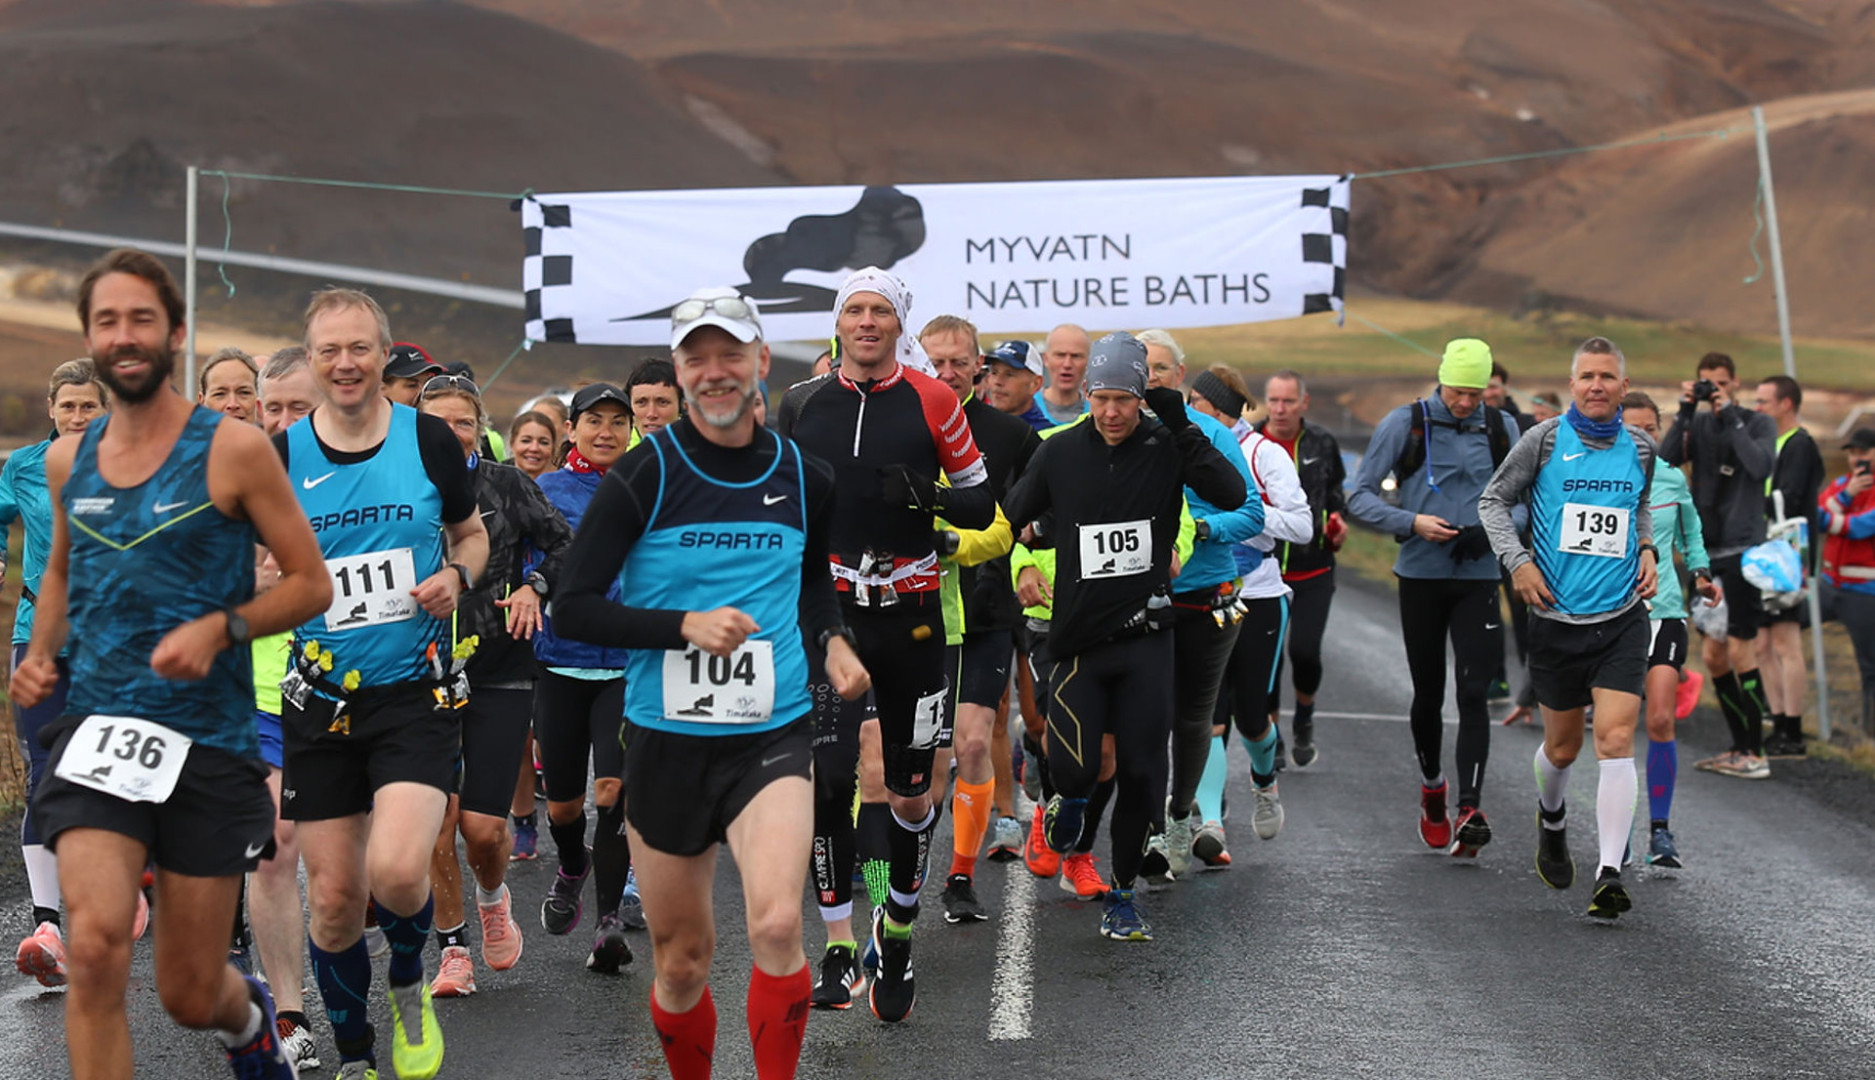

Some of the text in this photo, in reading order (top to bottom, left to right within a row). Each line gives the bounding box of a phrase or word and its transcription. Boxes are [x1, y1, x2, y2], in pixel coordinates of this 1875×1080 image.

[966, 234, 1130, 264] MYVATN
[967, 273, 1271, 310] NATURE BATHS
[1563, 479, 1634, 493] SPARTA
[311, 505, 413, 533] SPARTA
[1576, 511, 1618, 535] 139
[679, 532, 783, 549] SPARTA
[1093, 528, 1139, 554] 105
[335, 560, 395, 597] 111
[685, 650, 756, 687] 104
[96, 725, 167, 770] 136
